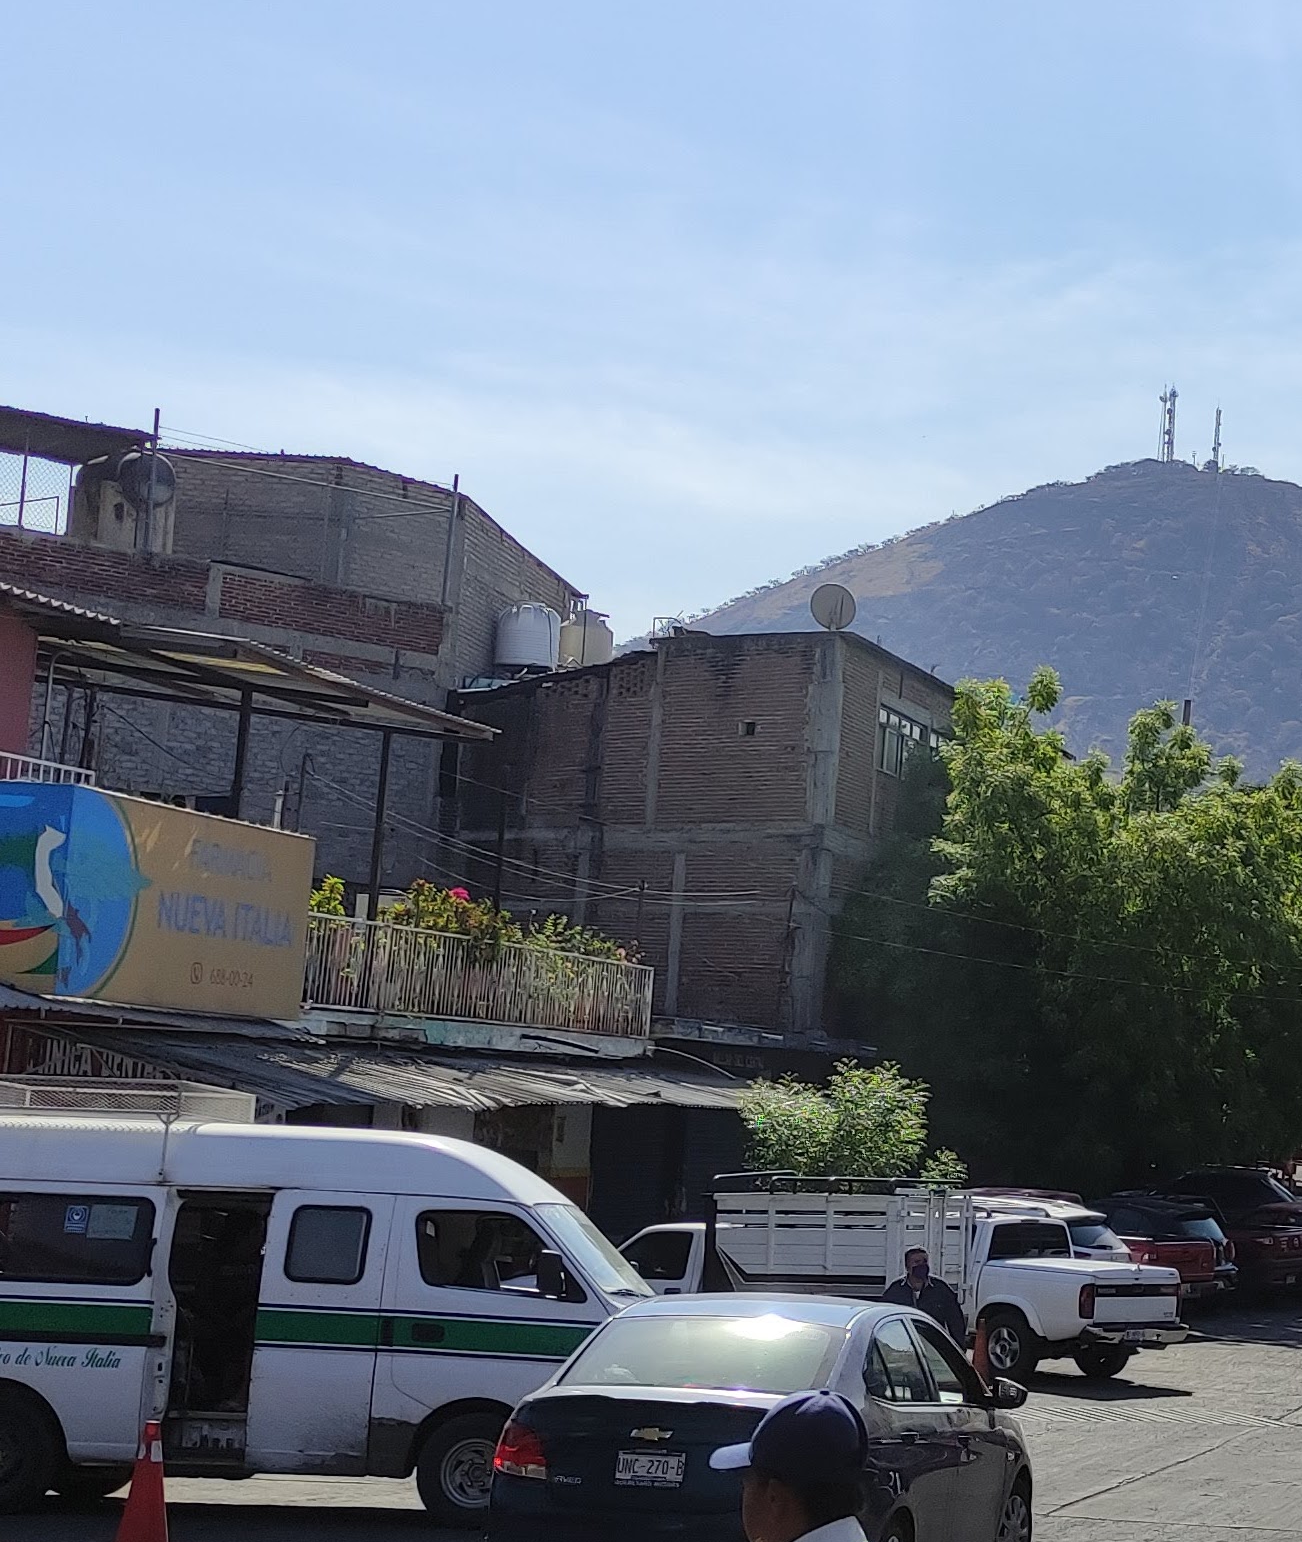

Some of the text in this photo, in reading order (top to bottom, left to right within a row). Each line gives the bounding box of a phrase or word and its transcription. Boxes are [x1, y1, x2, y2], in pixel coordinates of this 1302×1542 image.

[157, 890, 293, 948] NUEVA ITALIA
[15, 1347, 31, 1366] de
[81, 1347, 121, 1368] Italia
[617, 1458, 685, 1477] UNC-270-B
